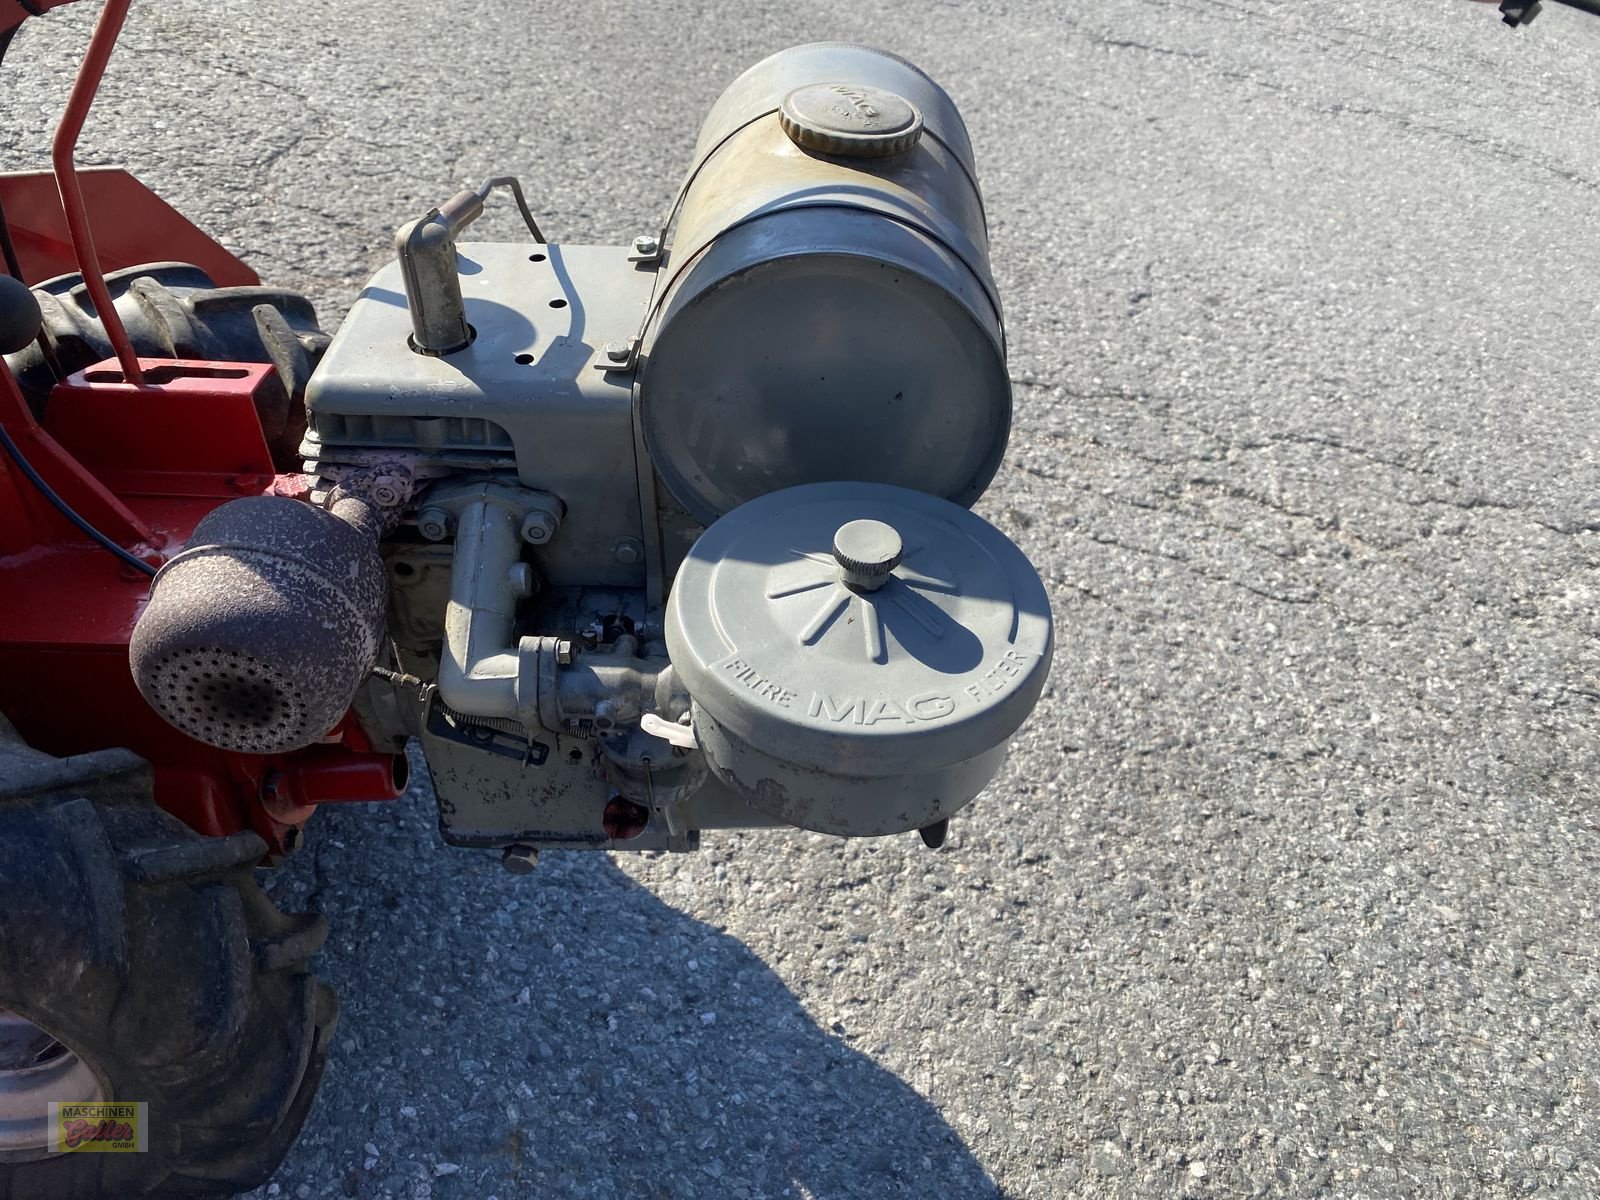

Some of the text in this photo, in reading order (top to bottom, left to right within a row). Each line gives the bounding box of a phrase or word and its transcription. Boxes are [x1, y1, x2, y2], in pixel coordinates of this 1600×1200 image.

[723, 649, 1029, 725] FILTRE MAG FILTER
